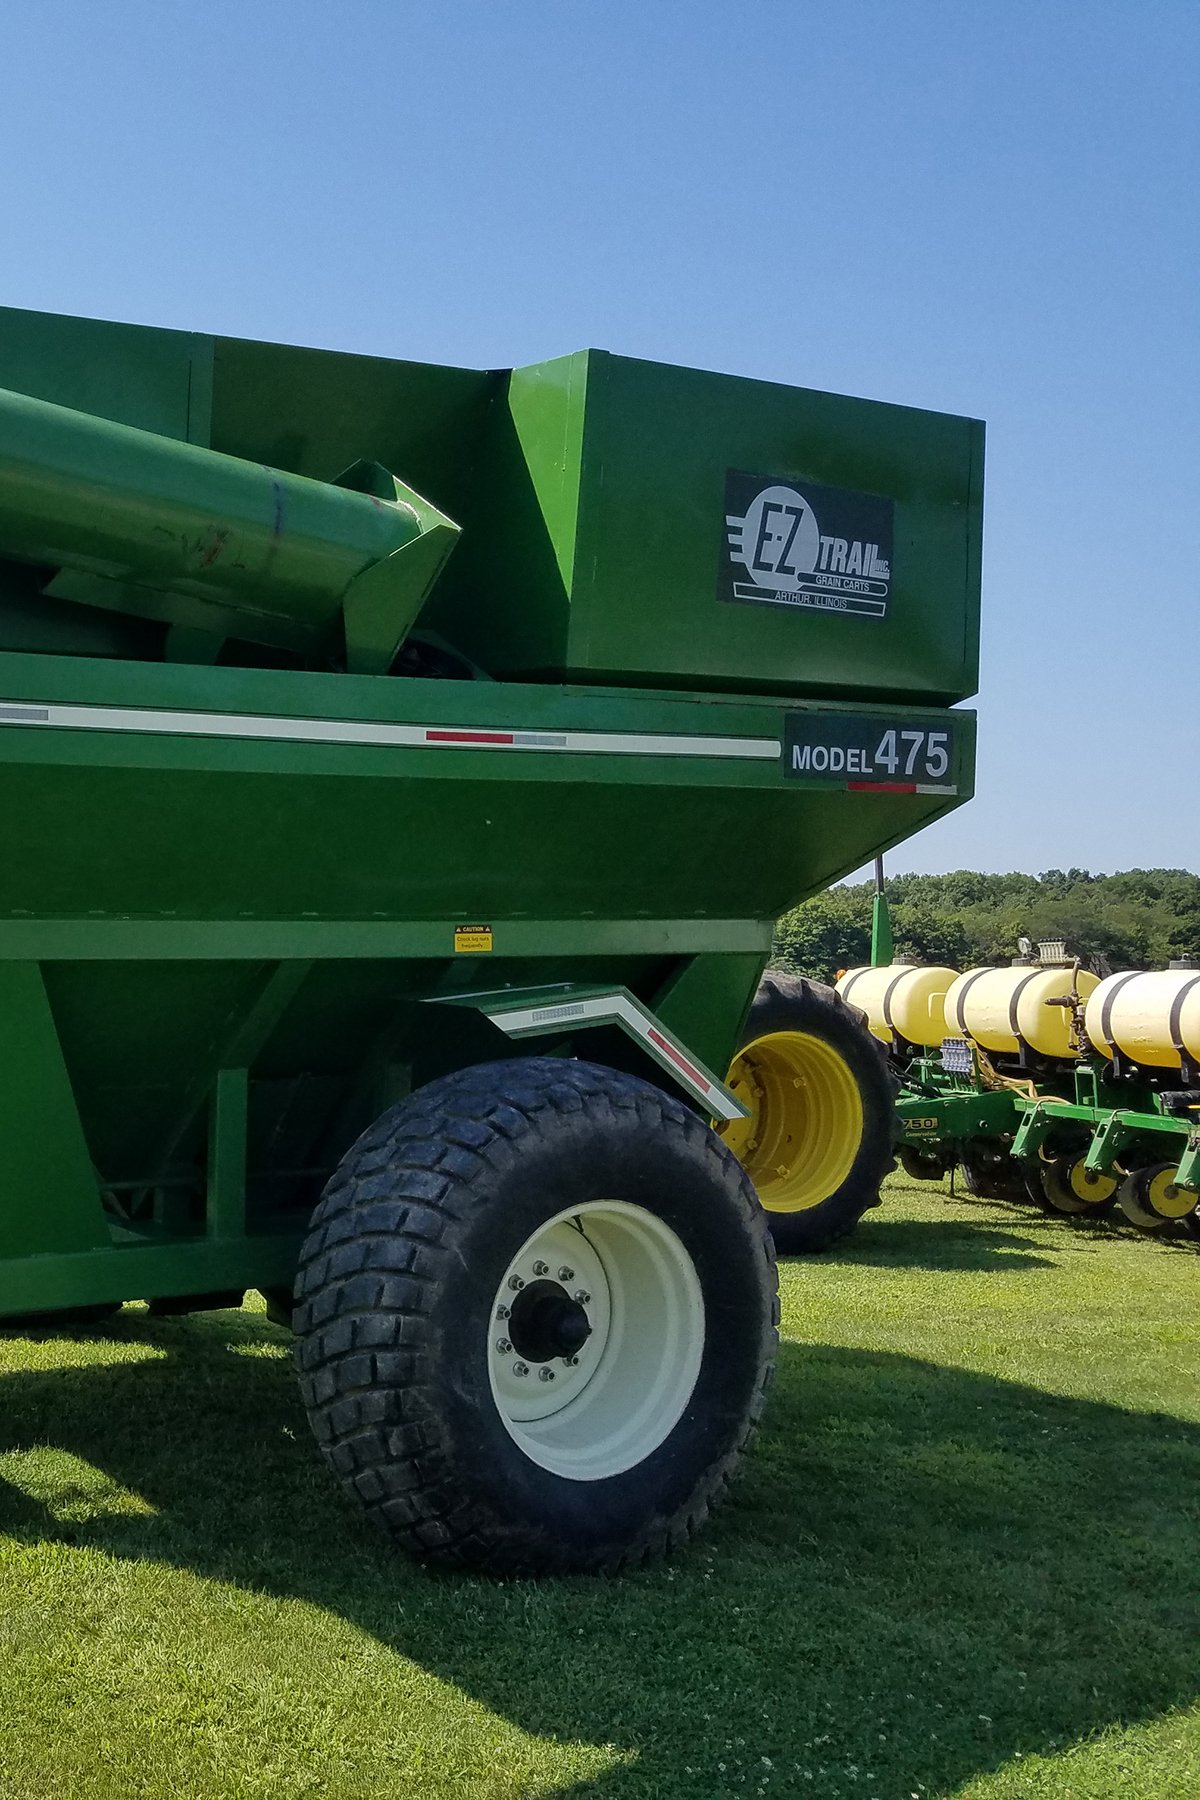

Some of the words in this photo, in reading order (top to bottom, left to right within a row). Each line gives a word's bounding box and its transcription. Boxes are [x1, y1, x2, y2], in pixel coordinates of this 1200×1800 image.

[816, 575, 840, 587] GRAIN
[843, 579, 869, 591] CARTS
[814, 596, 847, 608] ILLINOIS
[793, 745, 872, 773] MODEL
[875, 730, 948, 777] 475
